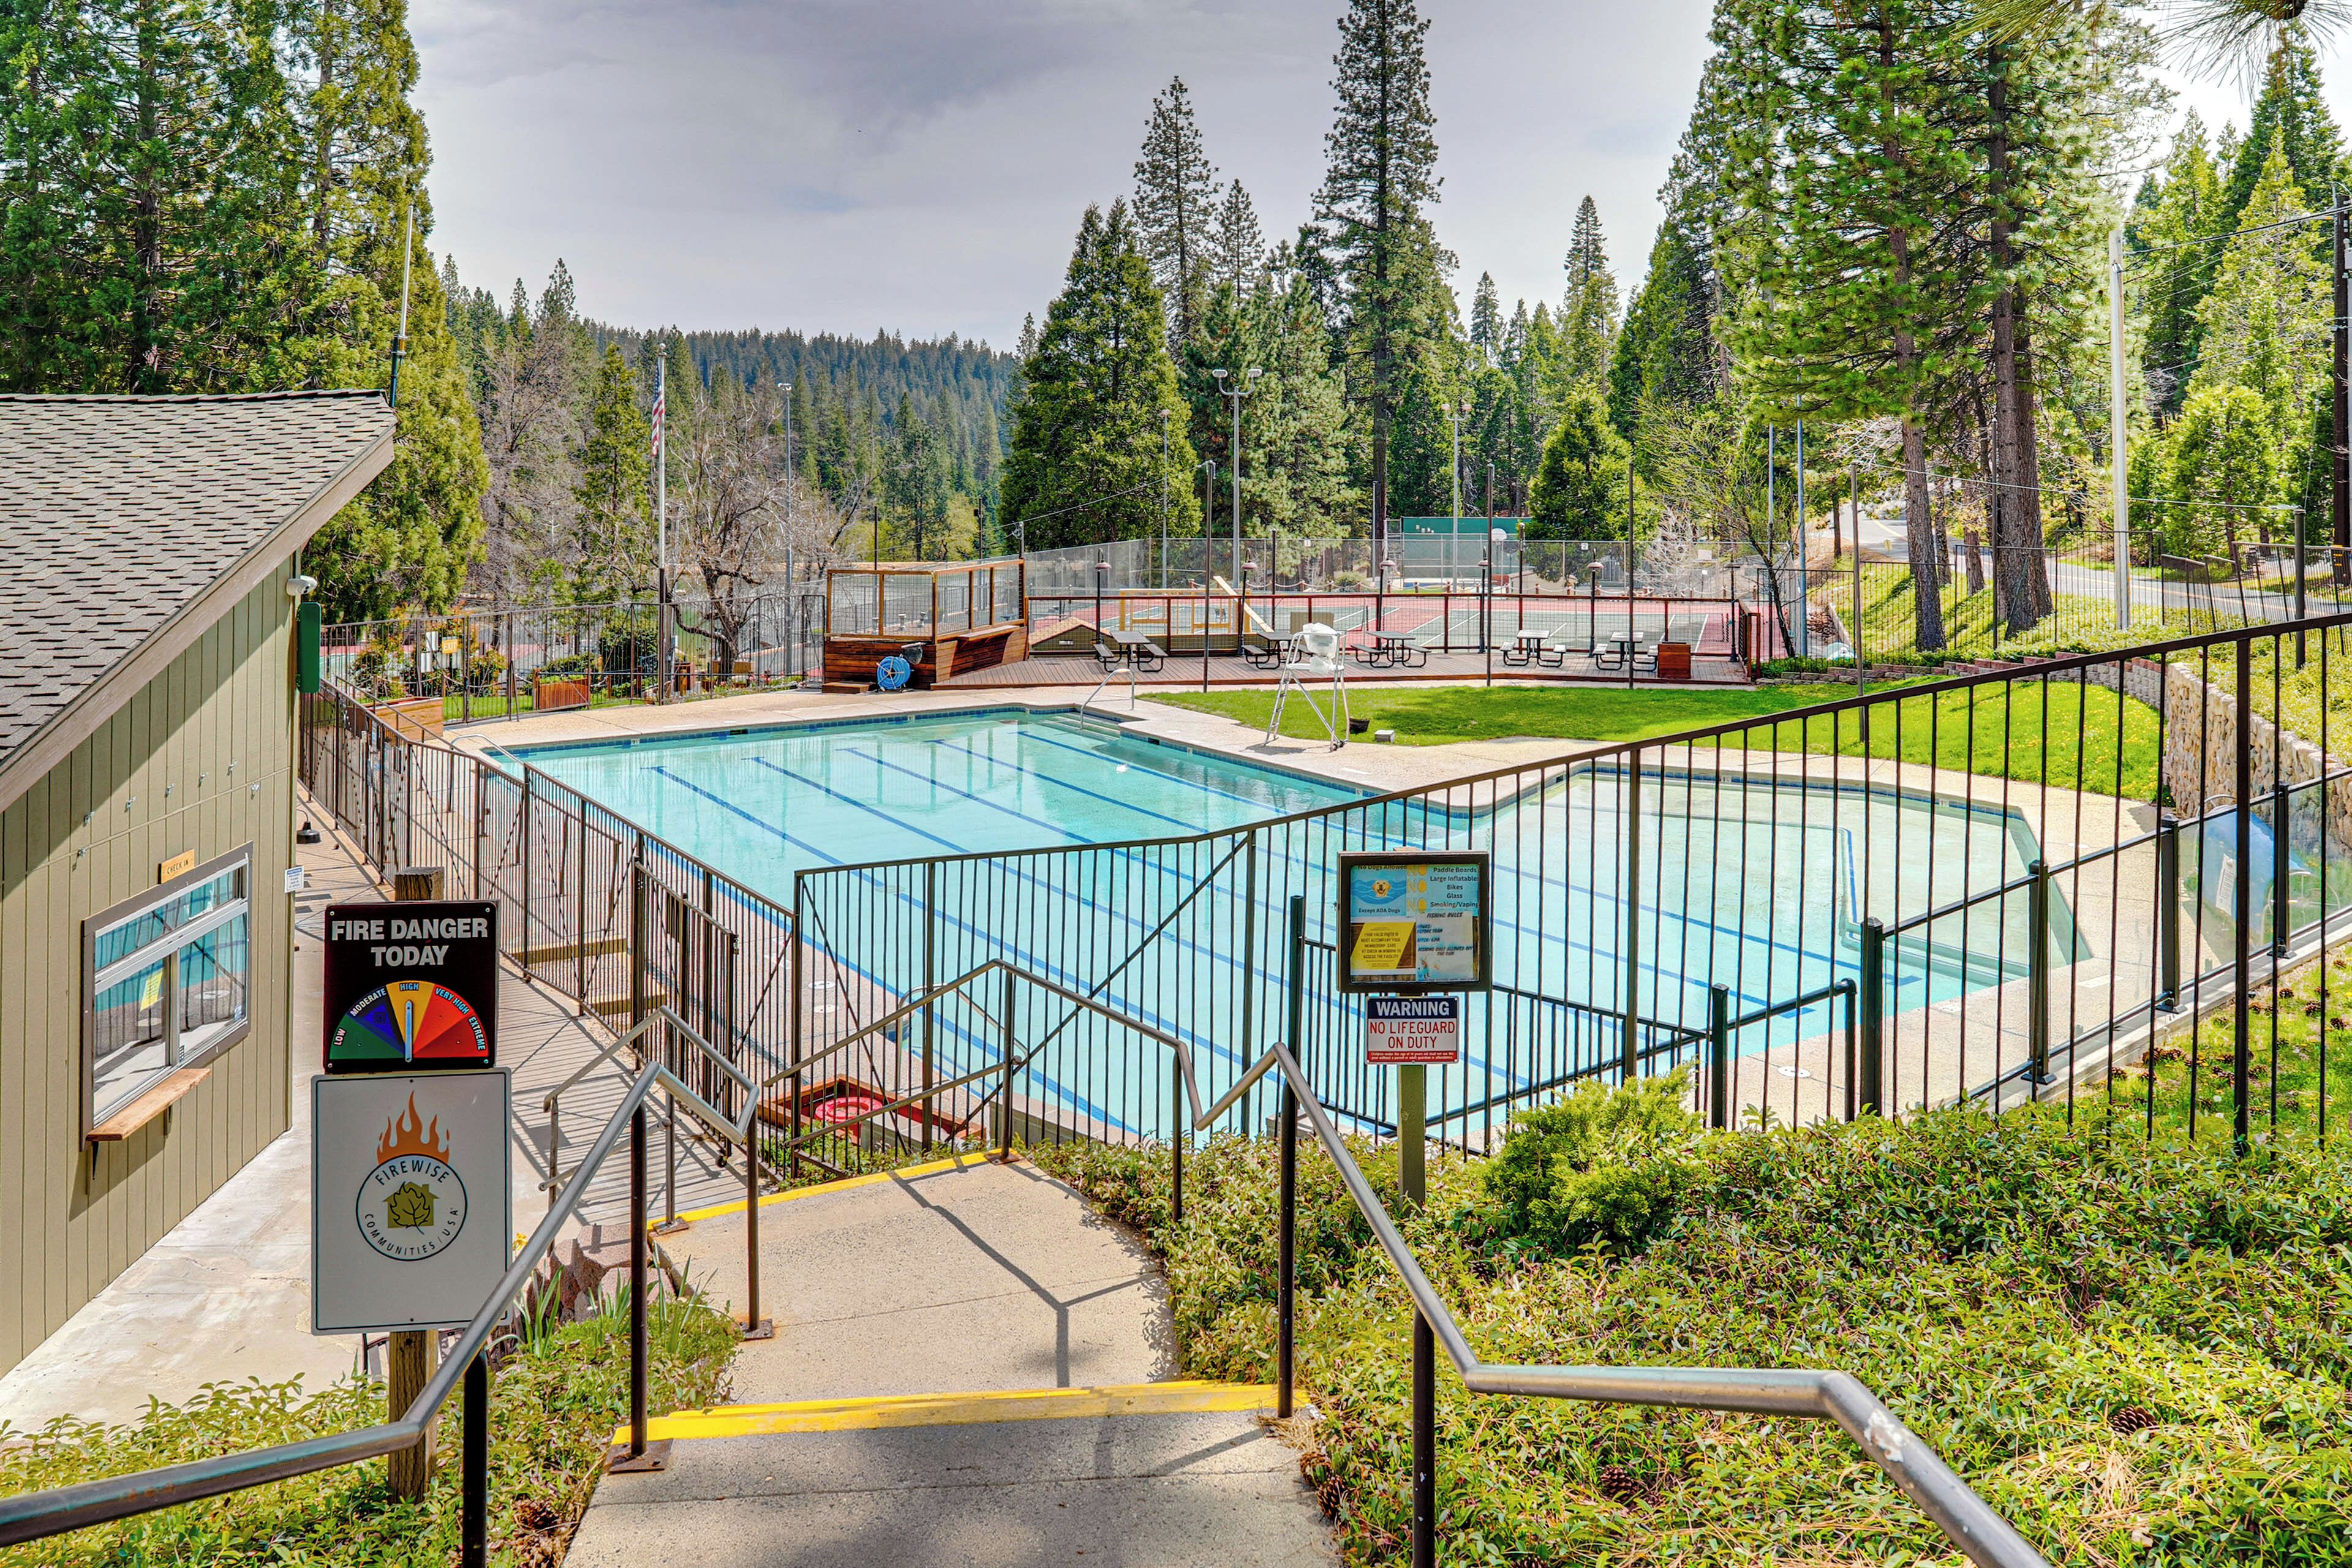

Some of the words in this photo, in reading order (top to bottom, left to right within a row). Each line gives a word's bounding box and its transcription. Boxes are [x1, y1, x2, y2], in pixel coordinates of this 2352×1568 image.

[167, 862, 183, 874] CHECK
[331, 920, 385, 941] FIRE
[391, 918, 488, 940] DANGER
[371, 945, 449, 967] TODAY
[350, 988, 386, 1017] MODERATE
[435, 987, 454, 1001] VERY
[453, 998, 470, 1014] HIGH
[1376, 1001, 1450, 1016] WARNING
[334, 1028, 346, 1046] LOW
[468, 1016, 486, 1050] EXTREME
[1370, 1022, 1385, 1035] NO
[1390, 1021, 1455, 1034] LIFEGUARD
[1388, 1036, 1403, 1049] ON
[1408, 1036, 1437, 1049] DUTY
[375, 1159, 450, 1186] FIREWISE
